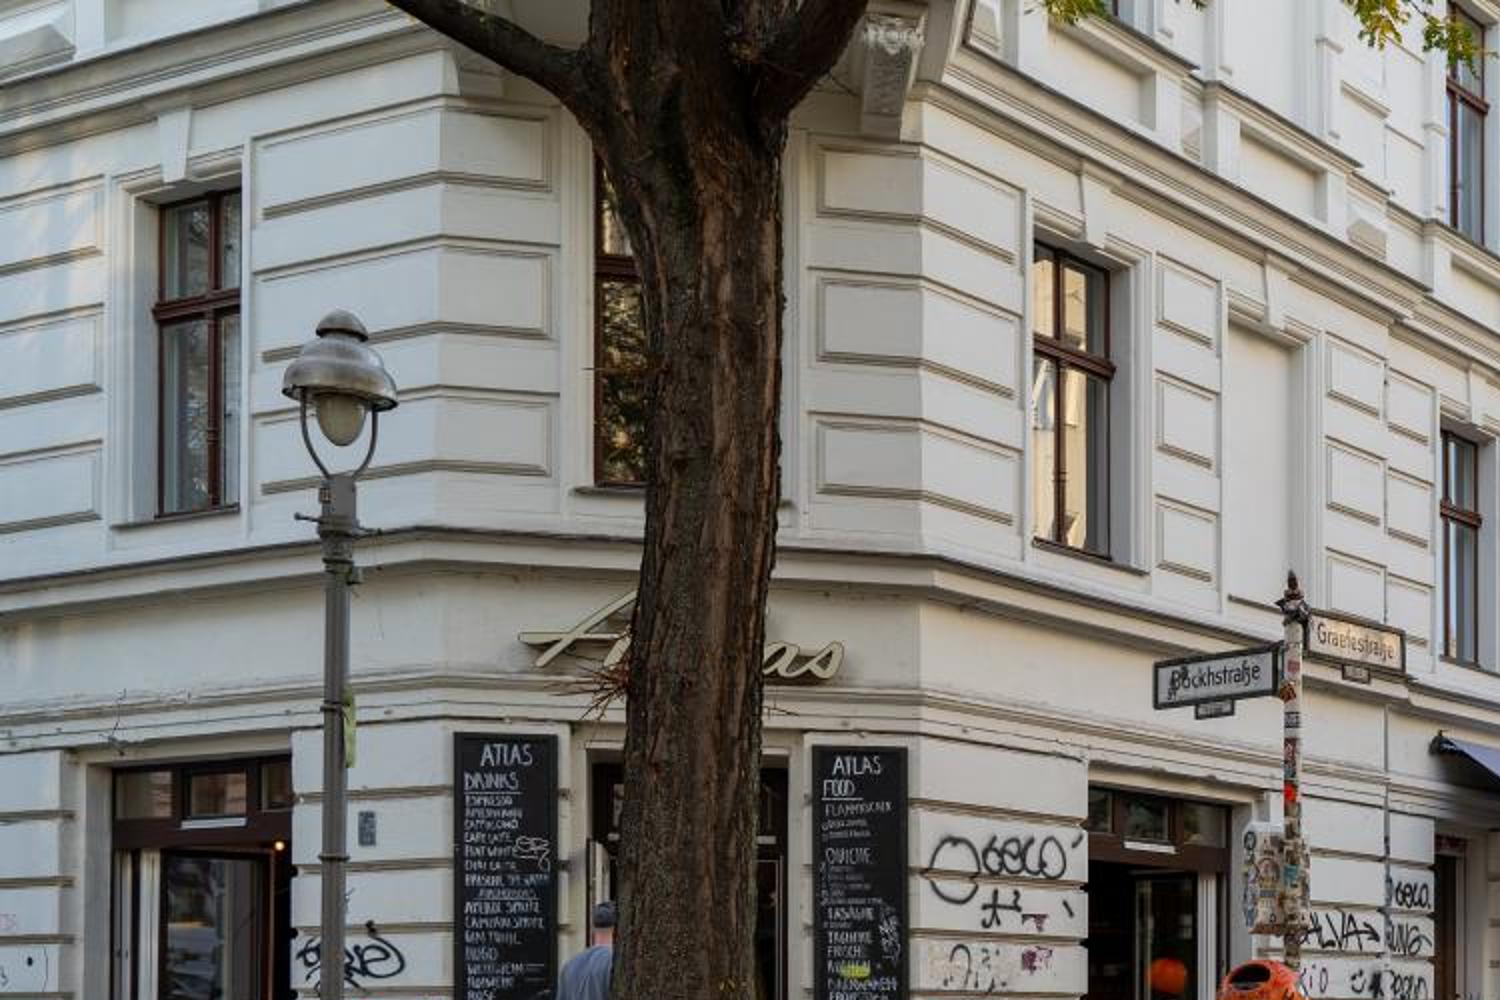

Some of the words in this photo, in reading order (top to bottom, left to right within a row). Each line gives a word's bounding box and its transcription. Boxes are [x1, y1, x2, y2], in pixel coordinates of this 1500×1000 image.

[517, 590, 846, 682] Aas
[1317, 622, 1394, 660] Graefestraße
[480, 744, 534, 766] ATLAS
[832, 755, 881, 776] ATLAS
[464, 772, 519, 791] DRINKS
[823, 779, 856, 797] FOOD
